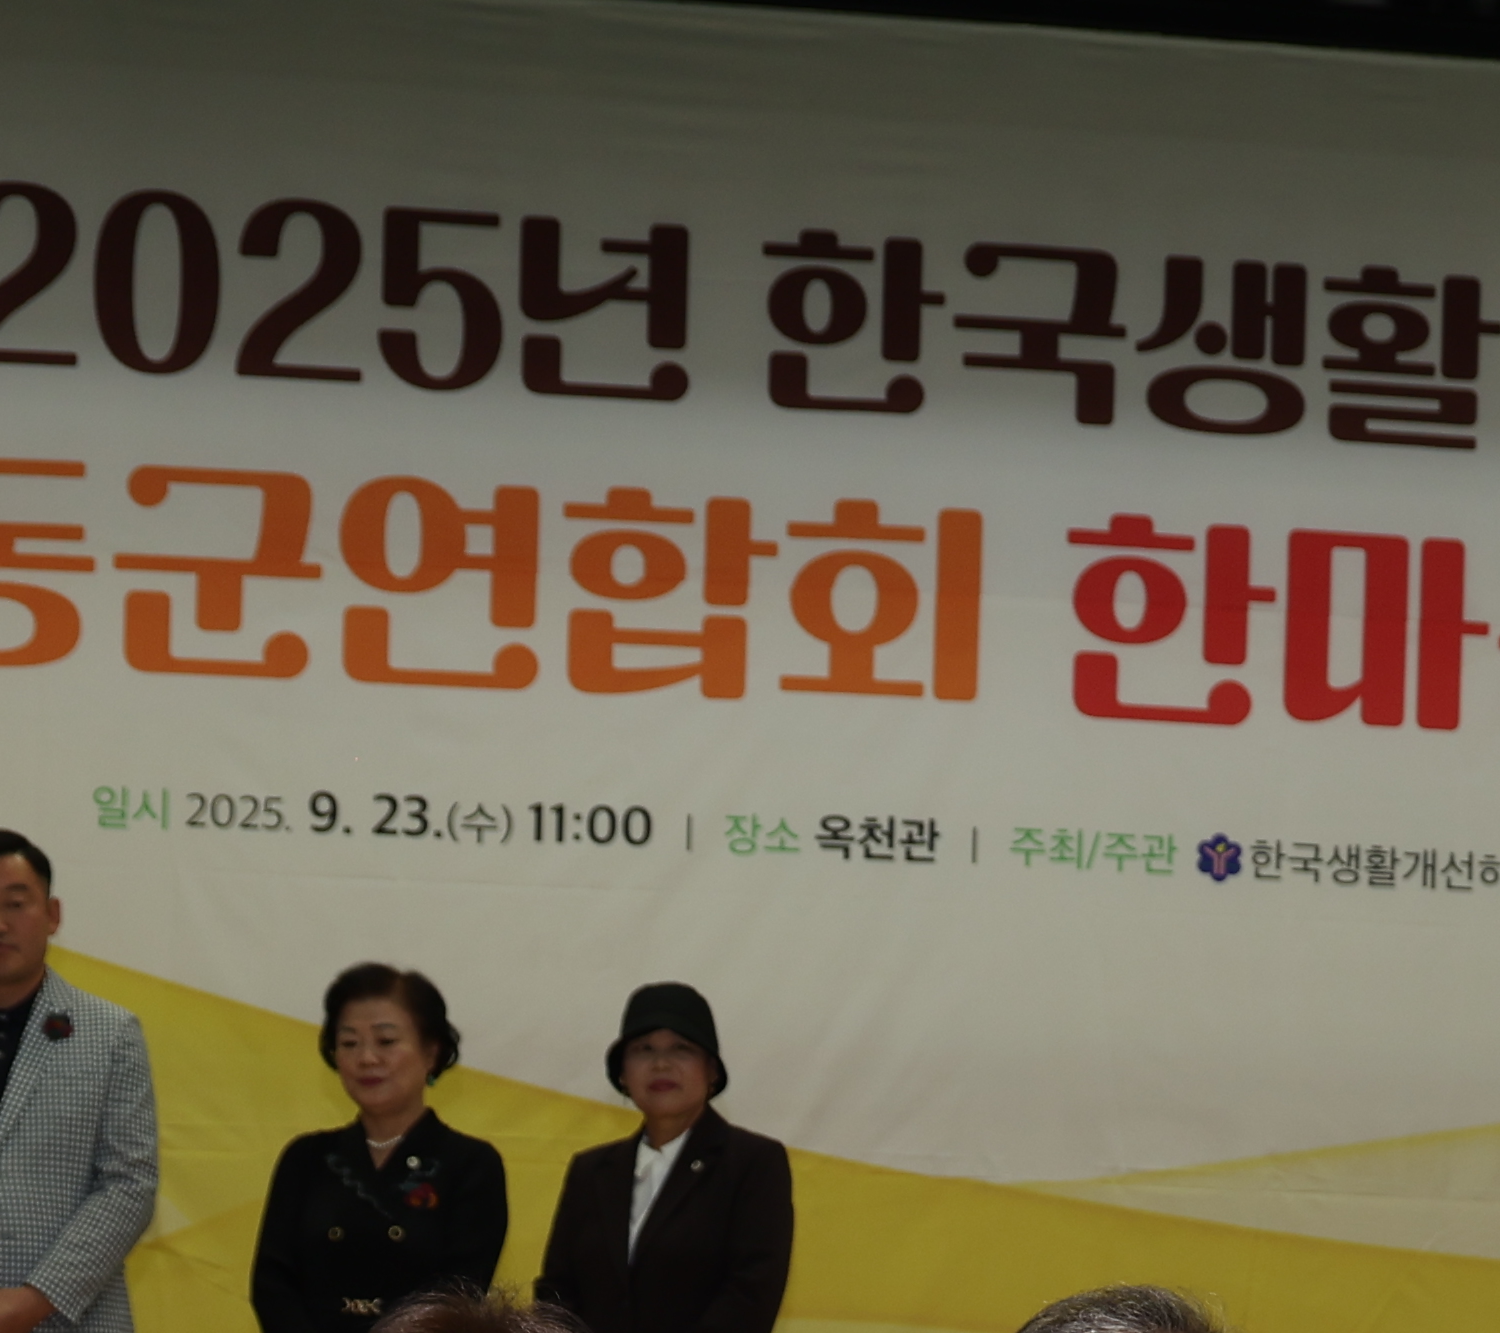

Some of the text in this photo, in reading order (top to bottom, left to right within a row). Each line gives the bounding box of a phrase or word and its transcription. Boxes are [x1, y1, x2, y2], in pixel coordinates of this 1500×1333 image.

[91, 785, 171, 829] 일시
[183, 793, 293, 833] 2025.
[309, 790, 351, 835] 9.
[530, 802, 653, 846] 11:00
[723, 814, 801, 856] 장소
[815, 814, 940, 863] 옥천관
[1009, 825, 1177, 875] 주최/주관
